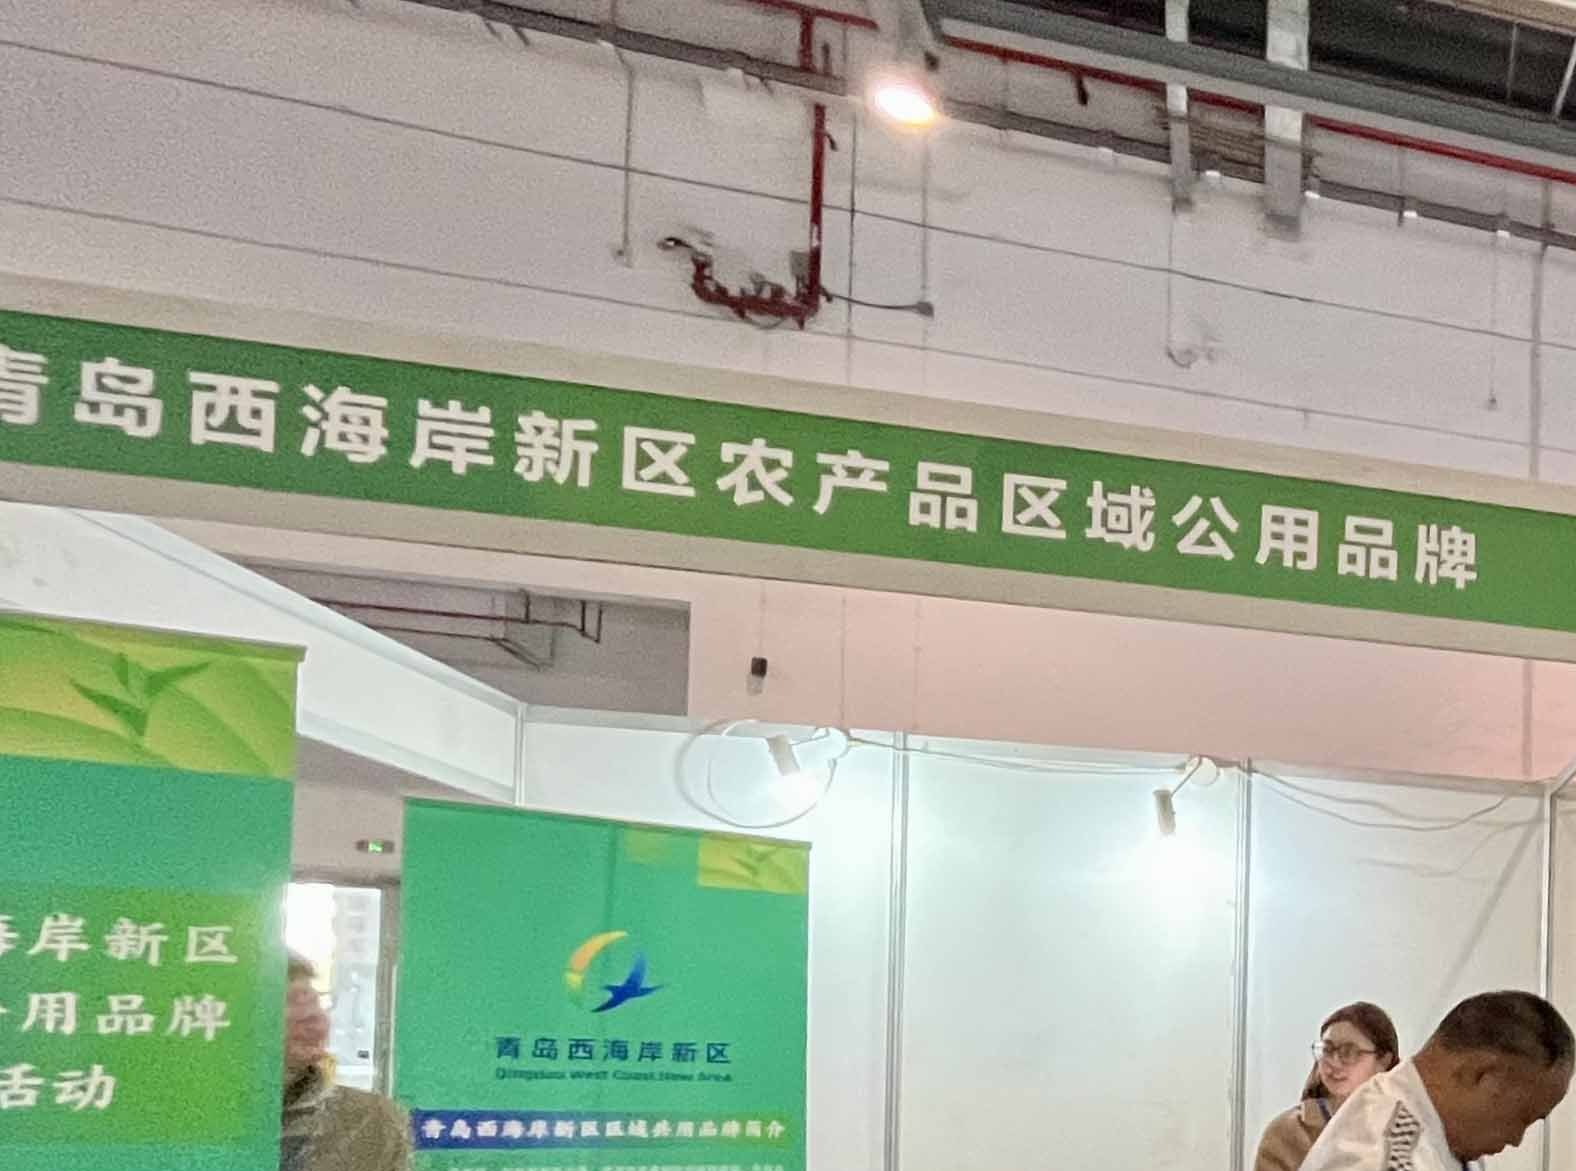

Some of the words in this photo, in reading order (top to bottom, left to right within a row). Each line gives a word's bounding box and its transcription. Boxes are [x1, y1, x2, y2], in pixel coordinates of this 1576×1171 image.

[0, 343, 1478, 590] 青岛西海岸新区农产品区域公用品牌
[0, 991, 231, 1041] 用品牌
[496, 1036, 732, 1064] 青岛西海岸新区
